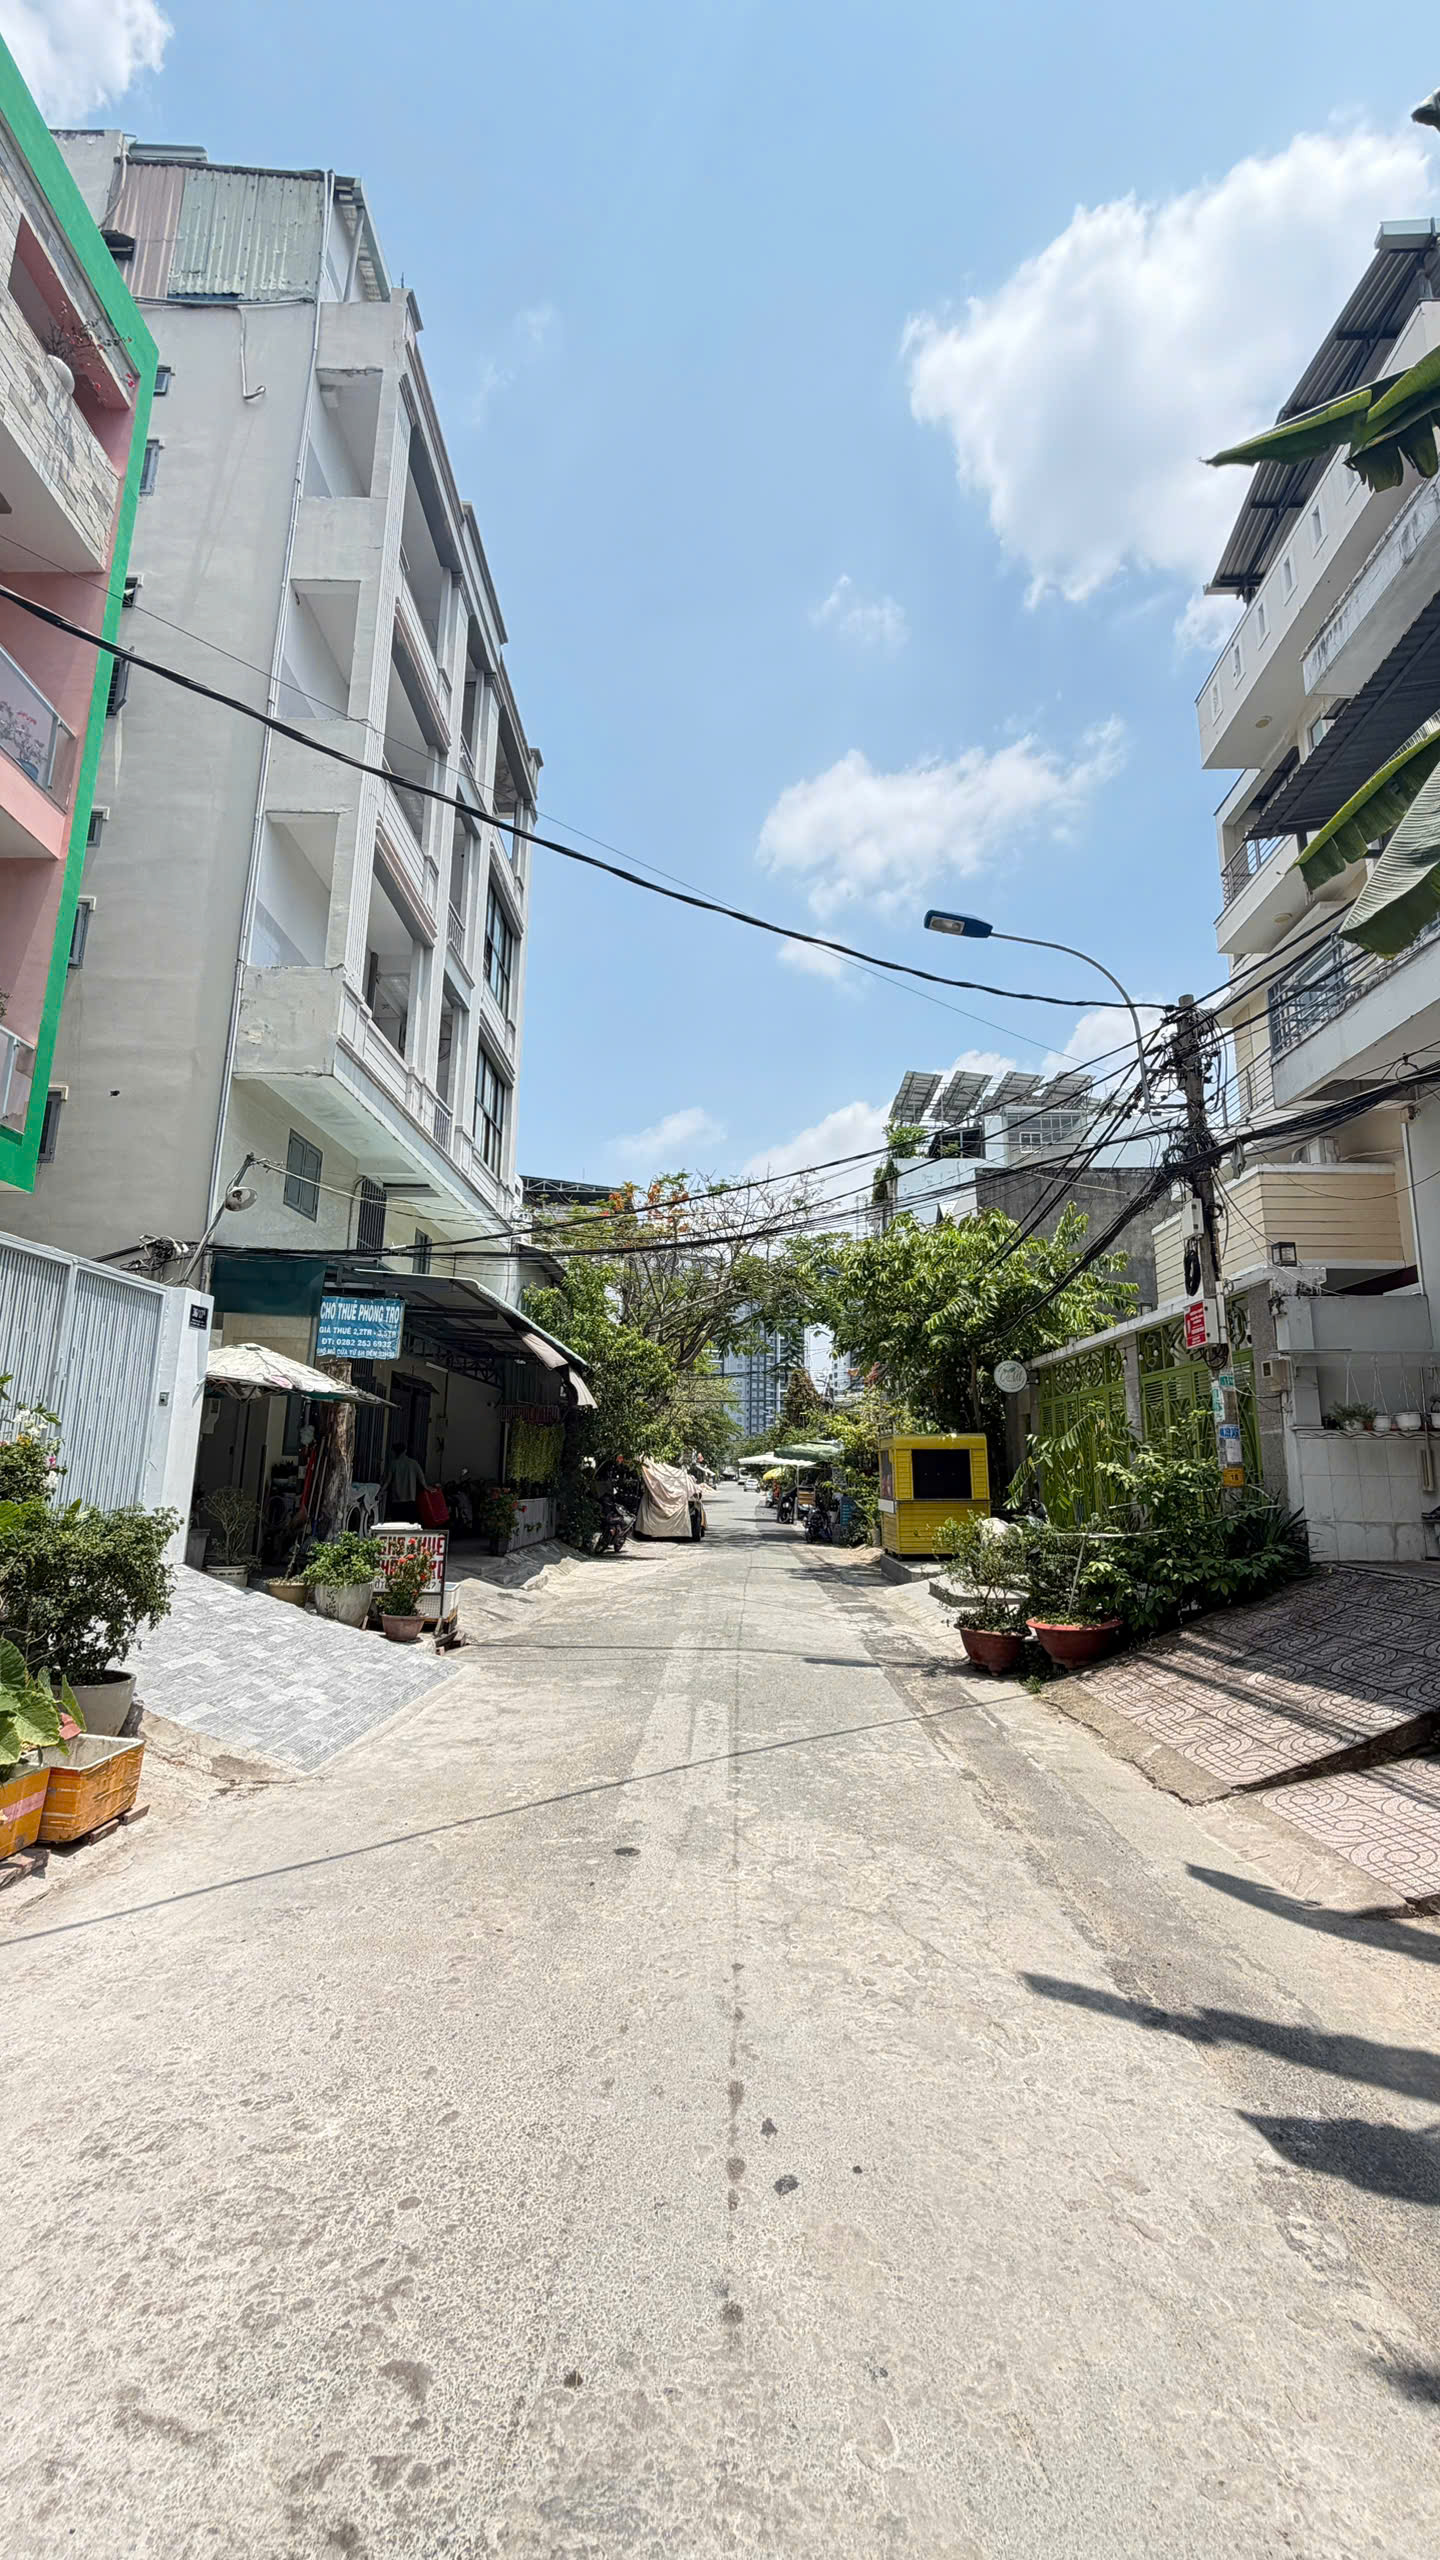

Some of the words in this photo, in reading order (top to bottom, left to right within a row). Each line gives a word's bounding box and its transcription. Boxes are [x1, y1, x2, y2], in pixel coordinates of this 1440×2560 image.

[320, 1301, 336, 1320] CHO
[337, 1300, 358, 1321] THUÊ
[358, 1301, 384, 1322] PHÒNG
[319, 1325, 331, 1334] GIÁ
